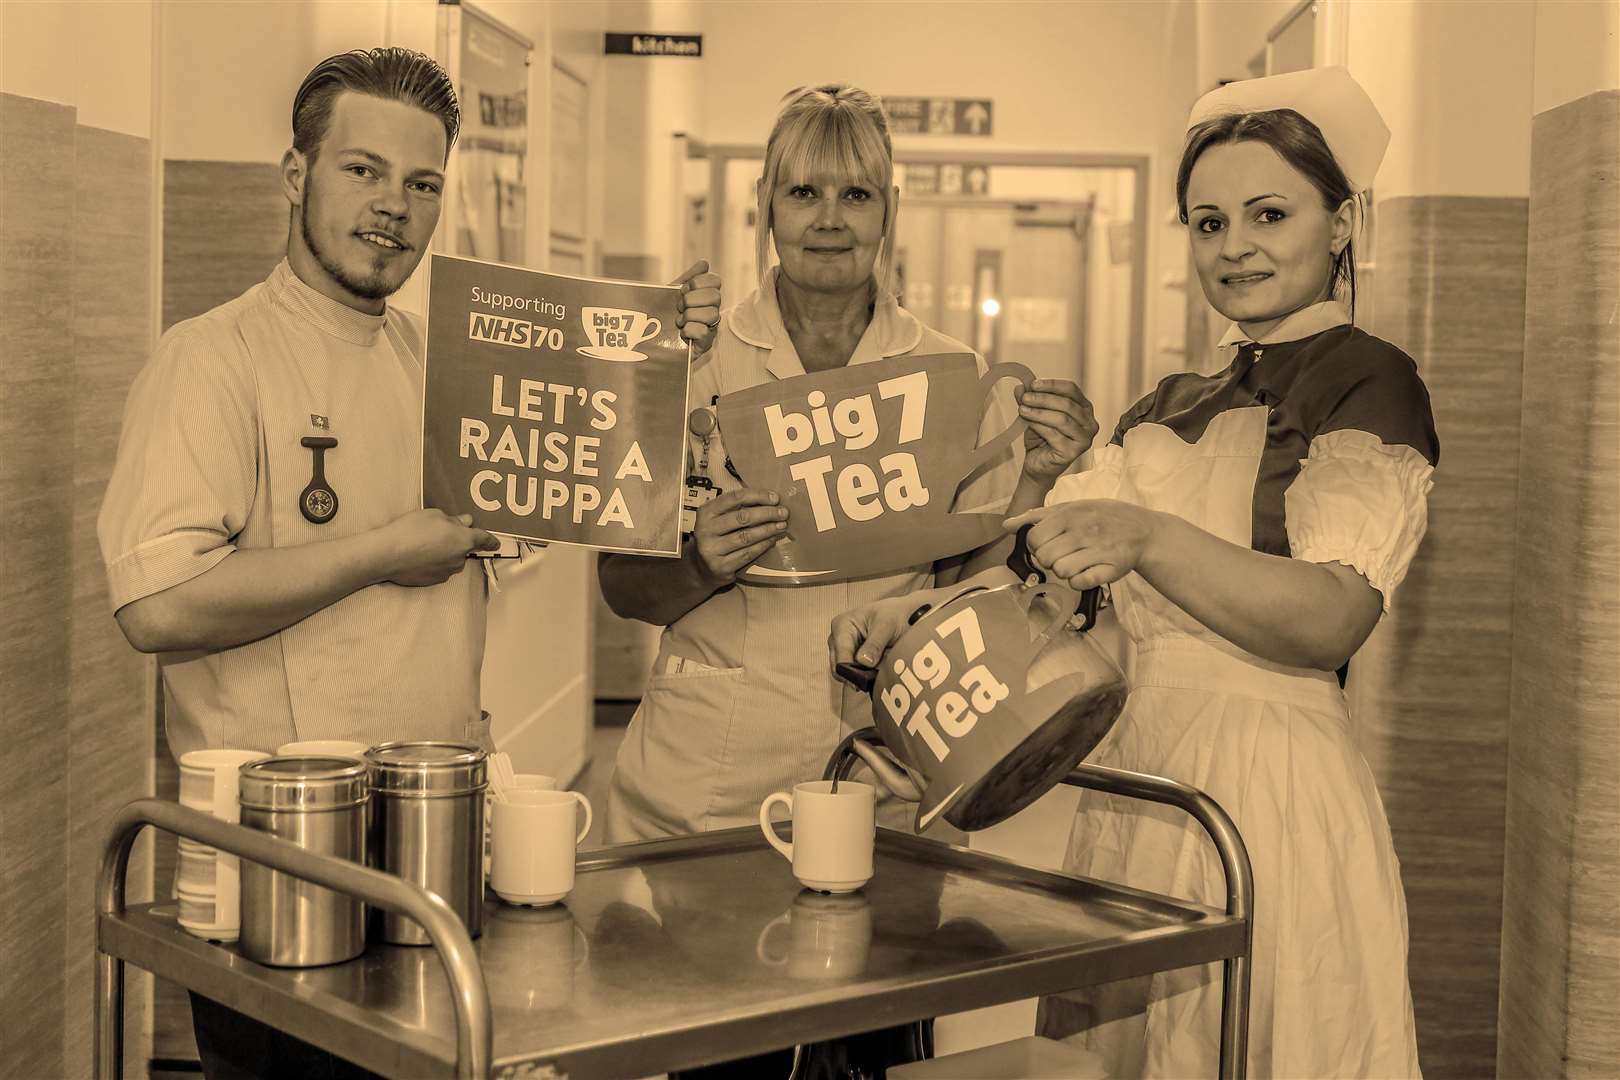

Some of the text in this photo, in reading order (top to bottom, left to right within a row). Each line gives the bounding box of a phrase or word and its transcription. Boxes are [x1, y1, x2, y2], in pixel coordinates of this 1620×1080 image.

[632, 35, 699, 54] kitchen
[471, 286, 567, 321] Supporting
[596, 328, 628, 348] Tea
[492, 374, 618, 431] LET’S
[459, 417, 653, 482] RAISE A
[469, 469, 634, 529] CUPPA
[790, 452, 930, 533] Tea
[906, 664, 1010, 763] Tea
